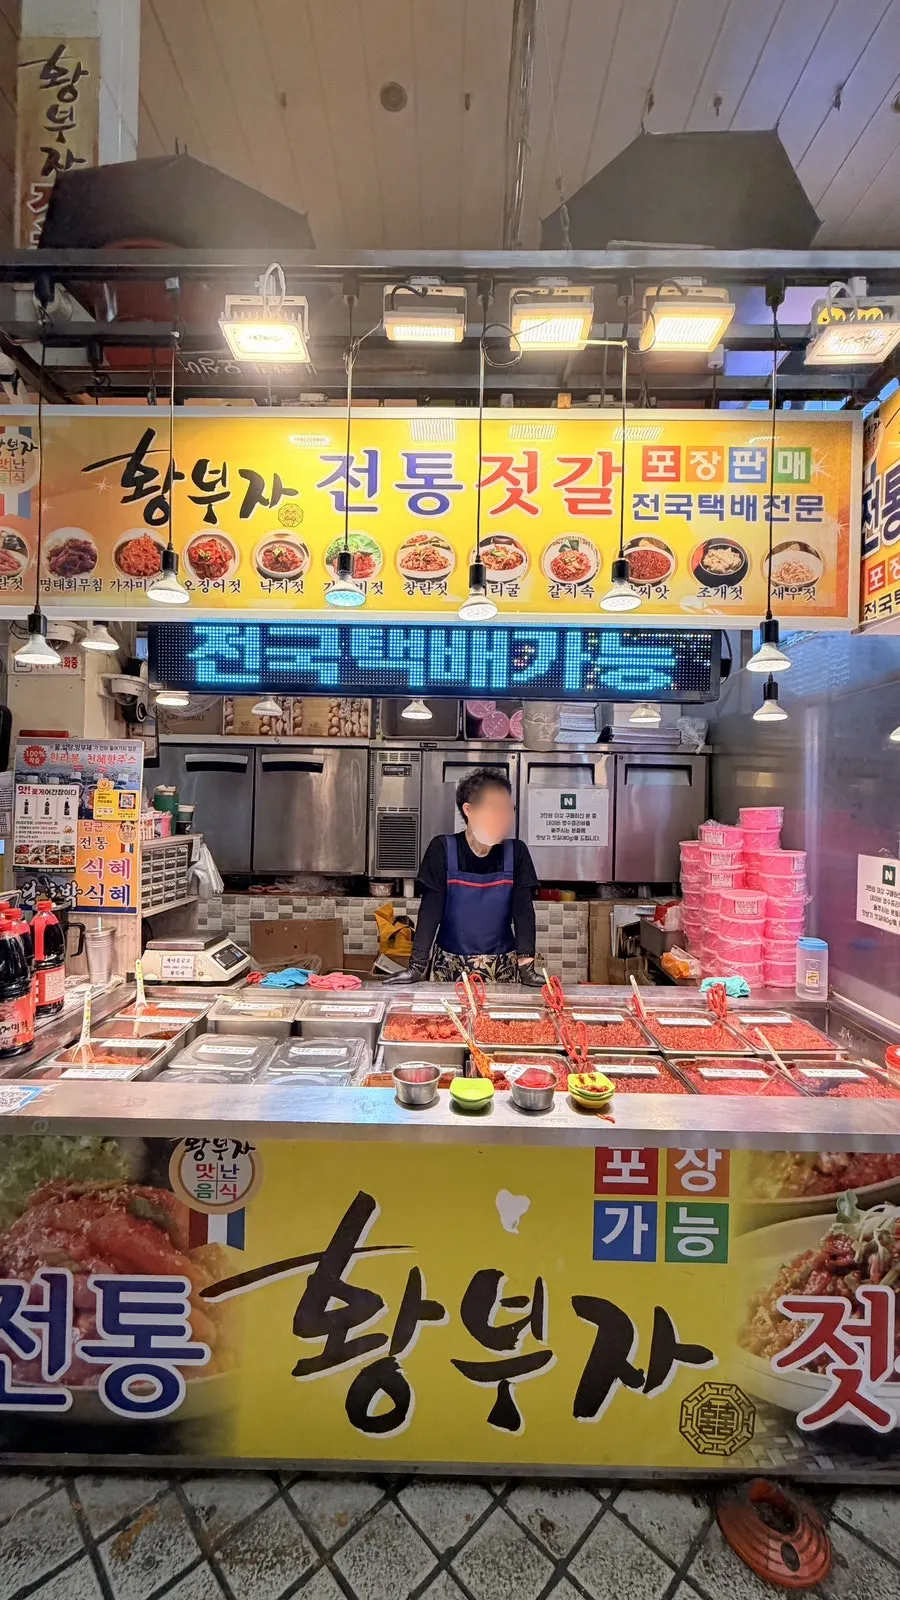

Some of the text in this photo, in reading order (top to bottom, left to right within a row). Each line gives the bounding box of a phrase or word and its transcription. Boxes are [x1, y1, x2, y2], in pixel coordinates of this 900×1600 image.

[81, 427, 298, 526] 황부자
[40, 578, 103, 592] 명태회무침
[110, 578, 159, 592] 가자미
[184, 579, 241, 594] 오징어젓
[260, 580, 304, 594] 낙지젓
[323, 580, 383, 595] 가비젓
[403, 580, 447, 596] 창란젓
[547, 584, 595, 599] 갈치속
[696, 585, 743, 601] 조개젓
[770, 585, 816, 601] 새우젓
[186, 626, 675, 691] 전국택배가능
[26, 750, 46, 758] 100%
[50, 753, 137, 766] 한라봉 천혜향주스
[79, 836, 109, 851] 전통
[82, 857, 131, 880] 식혜
[84, 883, 131, 907] 식혜
[196, 1163, 240, 1179] 맛난
[194, 1183, 237, 1200] 음식
[602, 1206, 720, 1257] 가능
[0, 1273, 205, 1413] 전통
[200, 1190, 714, 1433] 황부자
